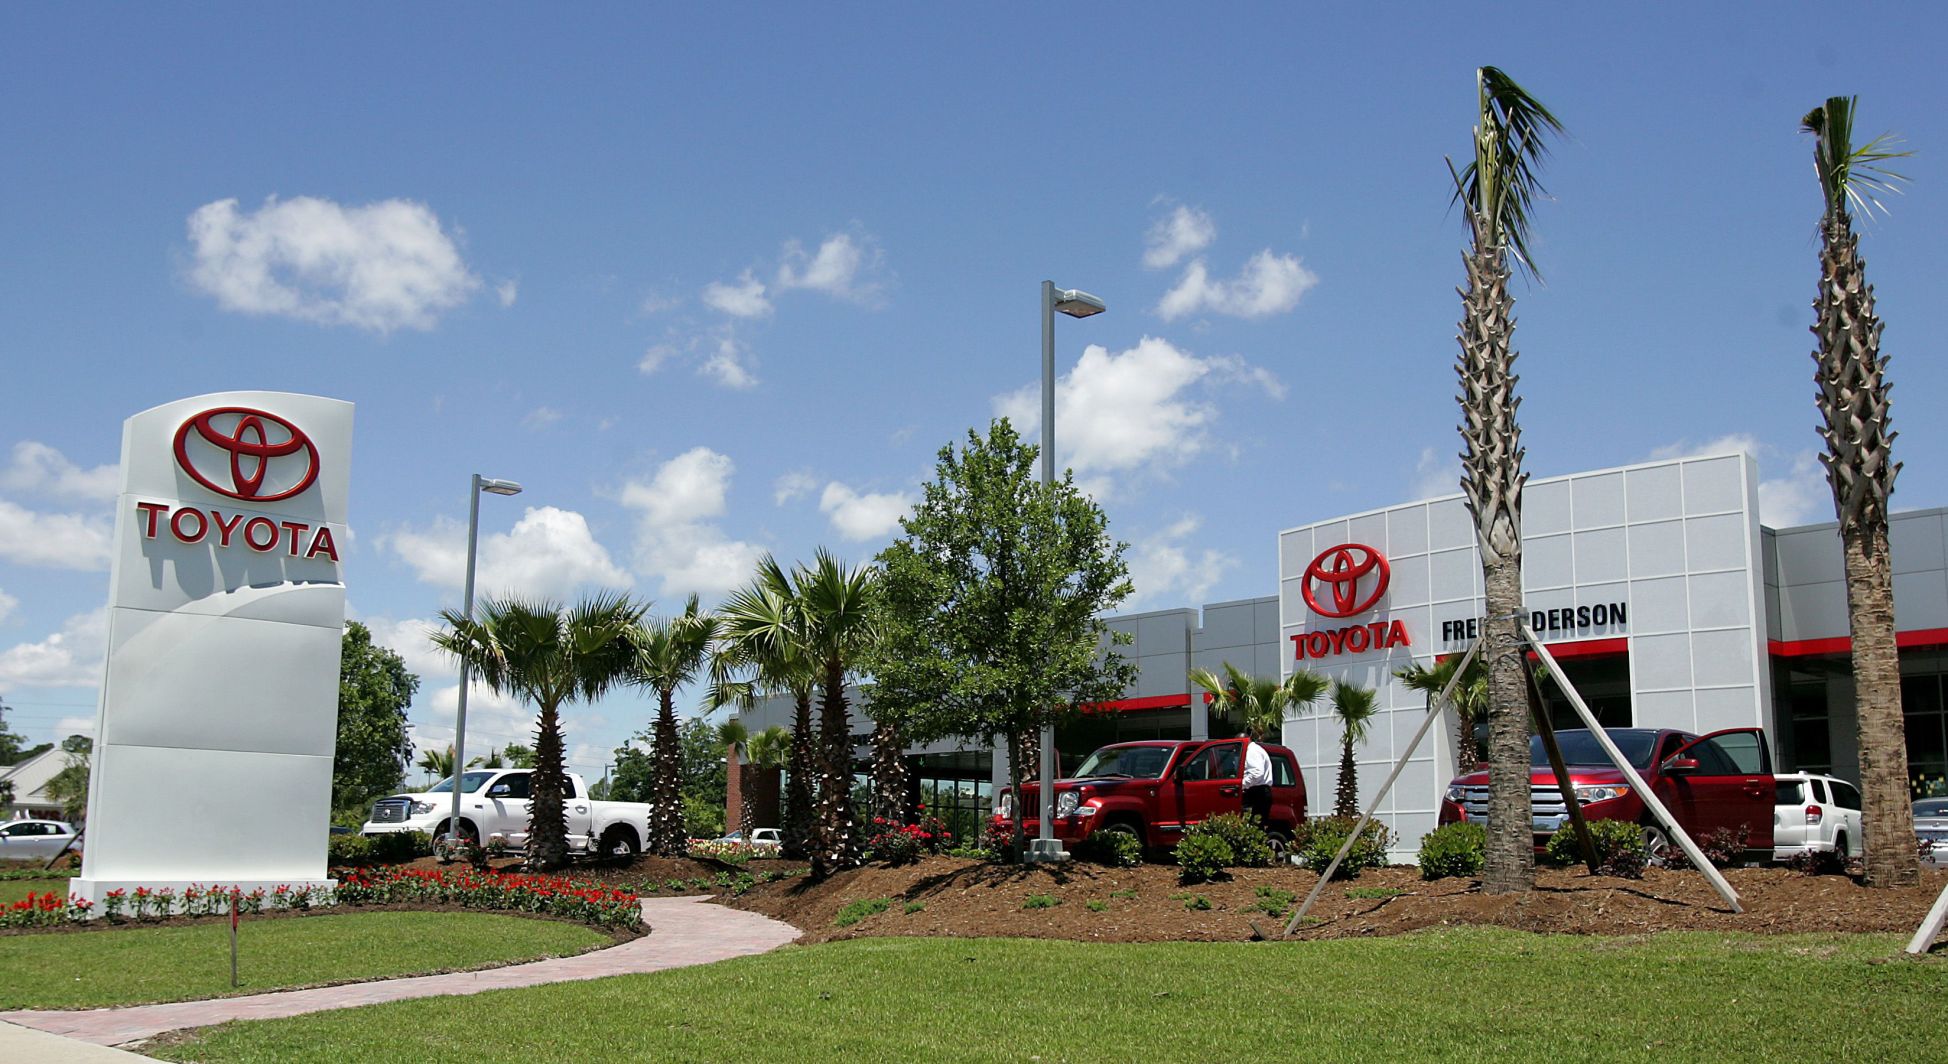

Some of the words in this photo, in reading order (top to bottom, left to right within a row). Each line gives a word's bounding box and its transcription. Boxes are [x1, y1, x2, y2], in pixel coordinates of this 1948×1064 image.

[137, 502, 339, 562] TOYOTA
[1290, 619, 1411, 660] TOYOTA
[1442, 618, 1477, 642] FRE
[1532, 602, 1627, 632] DERSON
